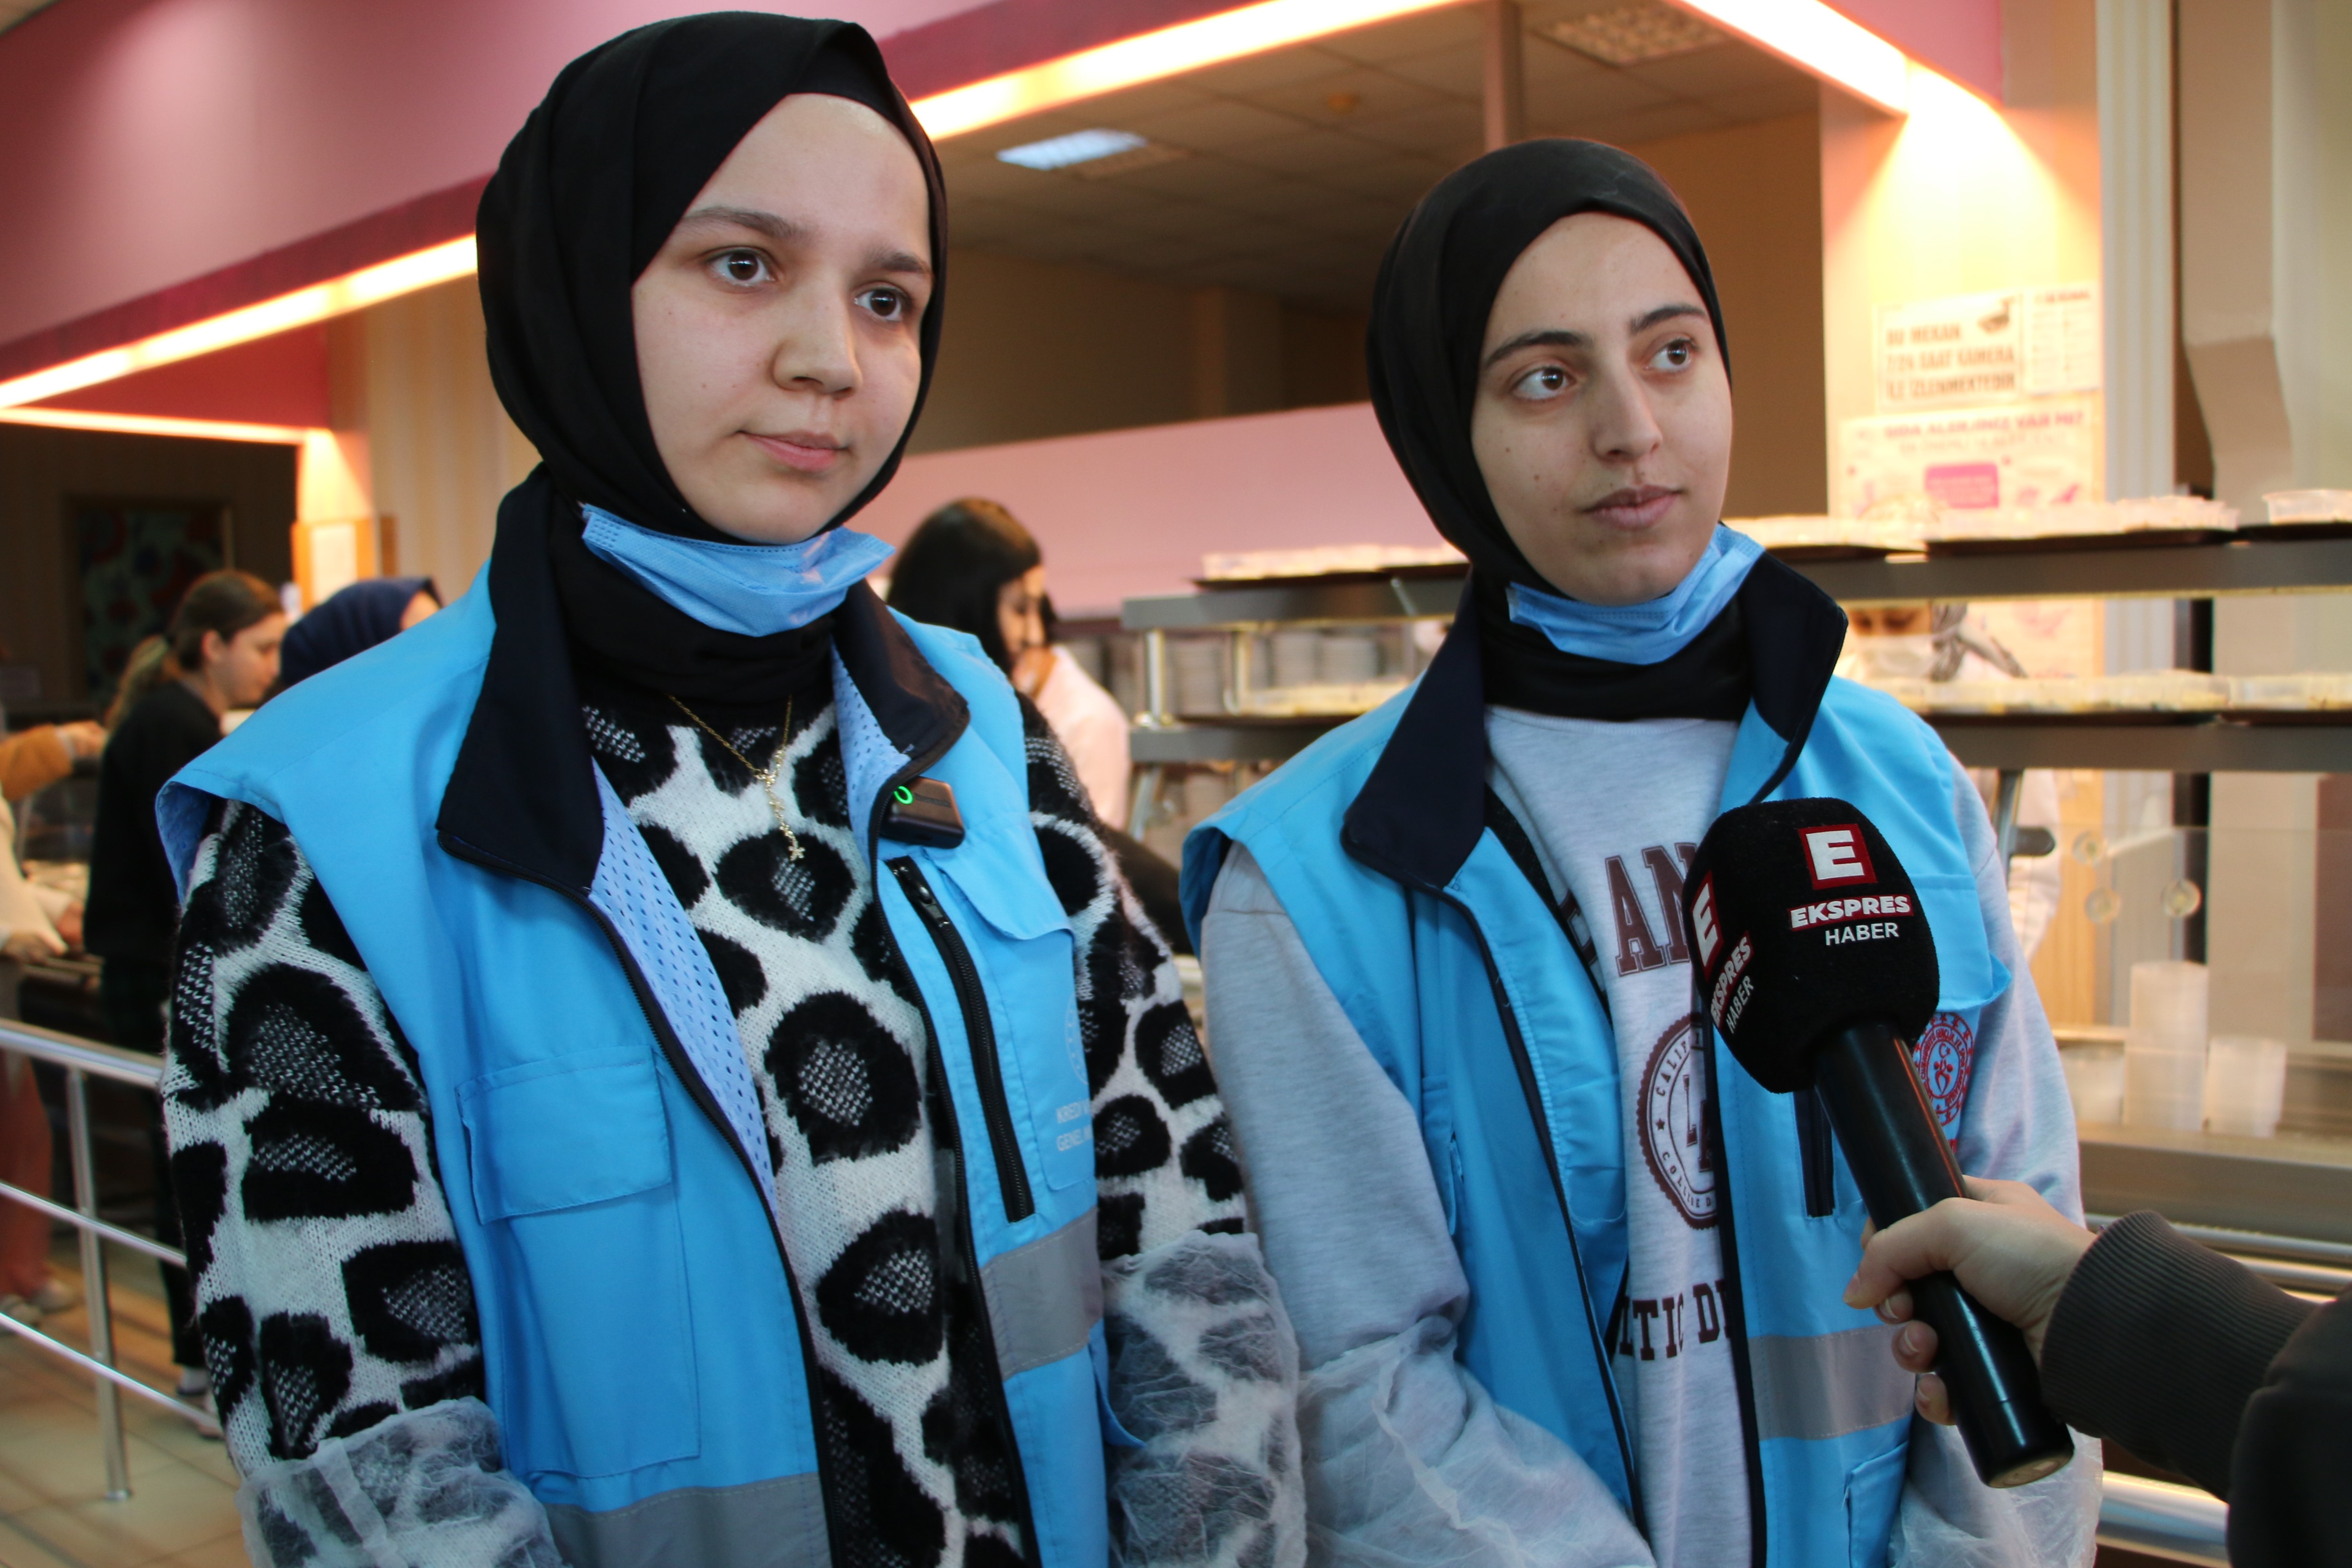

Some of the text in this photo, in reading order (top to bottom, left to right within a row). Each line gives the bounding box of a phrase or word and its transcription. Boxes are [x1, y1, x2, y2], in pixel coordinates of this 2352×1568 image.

[1910, 323, 1960, 344] MEKAN
[1920, 349, 1951, 369] SAAT
[1958, 345, 2015, 366] KAMERA
[1806, 830, 1865, 880] E
[1693, 883, 1718, 967] E
[1790, 896, 1910, 928] EKSPRES
[1825, 922, 1899, 946] HABER
[1710, 937, 1750, 1028] EKSPRES
[1726, 976, 1753, 1034] HABER
